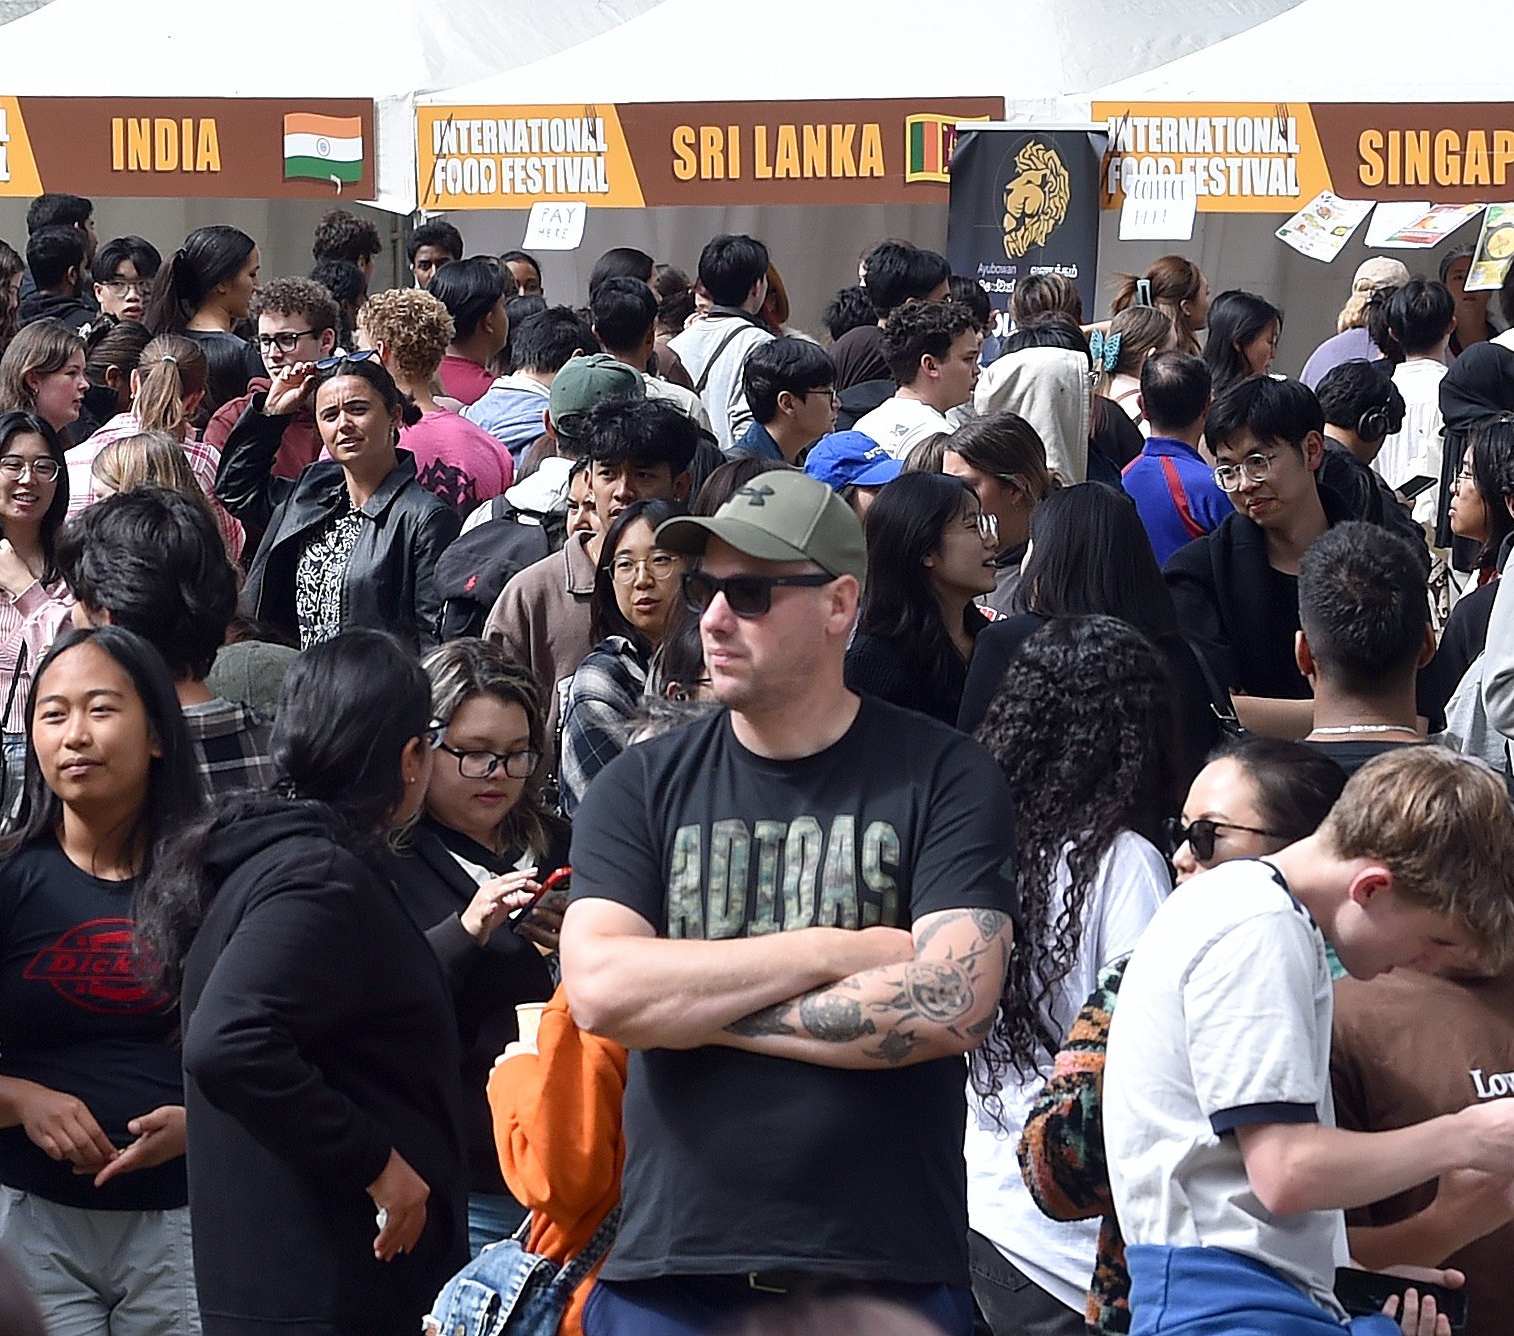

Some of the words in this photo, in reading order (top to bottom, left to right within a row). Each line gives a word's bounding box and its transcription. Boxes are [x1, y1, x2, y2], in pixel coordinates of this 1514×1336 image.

[112, 118, 221, 171] INDIA
[432, 117, 608, 154] INTERNATIONAL
[672, 125, 740, 180] SRI
[754, 123, 885, 179] LANKA
[1106, 116, 1300, 154] INTERNATIONAL
[434, 157, 497, 194] FOOD
[501, 156, 609, 194] FESTIVAL
[1182, 156, 1300, 196] FESTIVAL
[541, 207, 578, 224] PAY
[668, 814, 900, 940] ADIDAS
